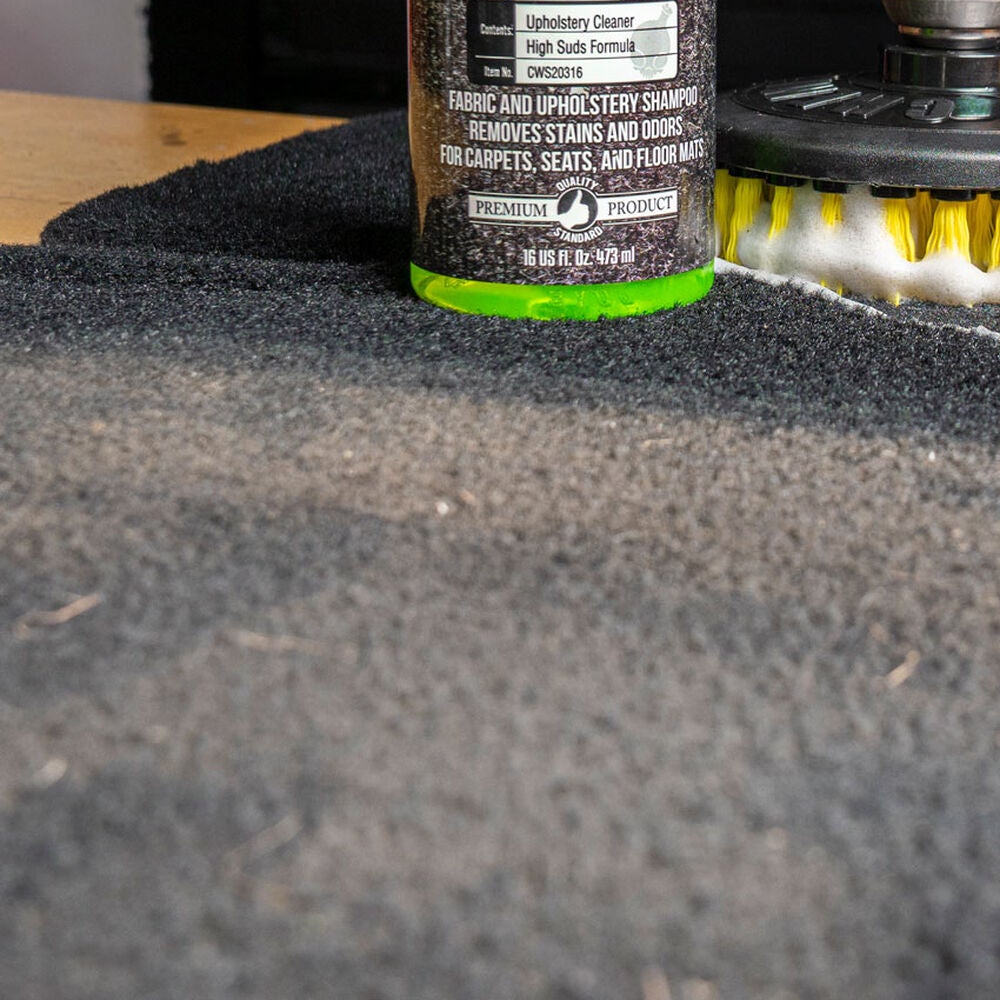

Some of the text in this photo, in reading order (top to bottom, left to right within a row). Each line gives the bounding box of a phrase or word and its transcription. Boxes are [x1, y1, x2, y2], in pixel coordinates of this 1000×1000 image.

[480, 22, 514, 36] Contents:
[526, 14, 635, 33] Upholstery Cleaner
[526, 38, 636, 56] High Suds Formula
[483, 66, 500, 78] Item
[527, 66, 583, 80] CWS20316
[449, 86, 698, 117] FABRIC AND UPHOLSTERY SHAMPOO
[469, 116, 683, 145] REMOVES STAINS AND ODORS
[440, 140, 705, 174] FOR CARPETS, SEATS, AND FLOOR MATS
[556, 177, 599, 190] QUALITY
[475, 195, 673, 218] PREMIUM PRODUCT
[553, 226, 603, 244] STANDARD
[523, 249, 535, 265] 16
[539, 249, 556, 266] US
[576, 249, 593, 266] Oz.
[597, 248, 618, 265] 473
[621, 246, 635, 264] ml
